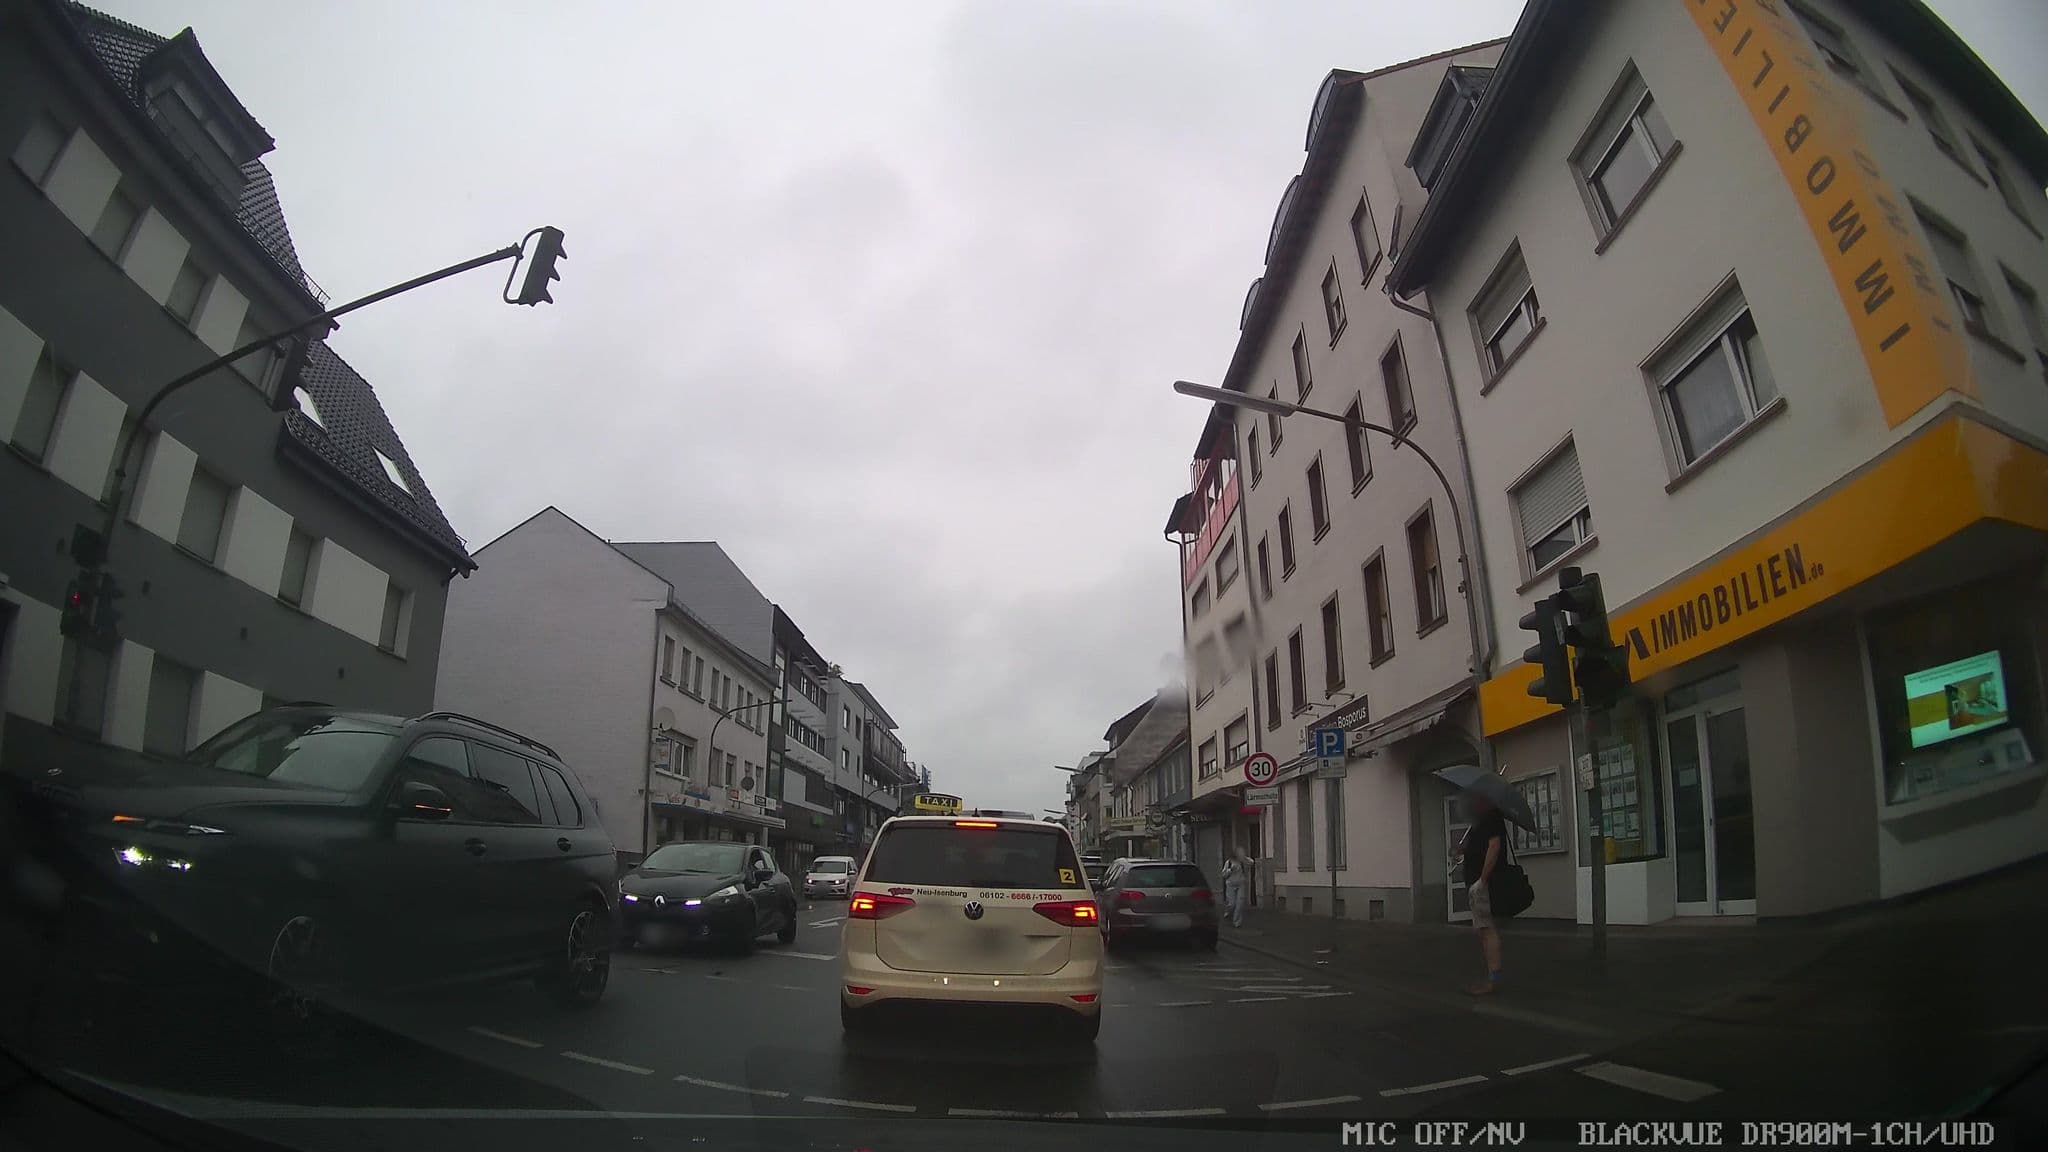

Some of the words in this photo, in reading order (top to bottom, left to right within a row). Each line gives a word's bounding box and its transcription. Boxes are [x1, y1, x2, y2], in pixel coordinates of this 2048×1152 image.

[1322, 732, 1338, 755] P
[1251, 761, 1270, 776] 30
[925, 796, 953, 807] TAXI
[1064, 871, 1074, 882] 2
[916, 889, 968, 898] Neu-Isenburg
